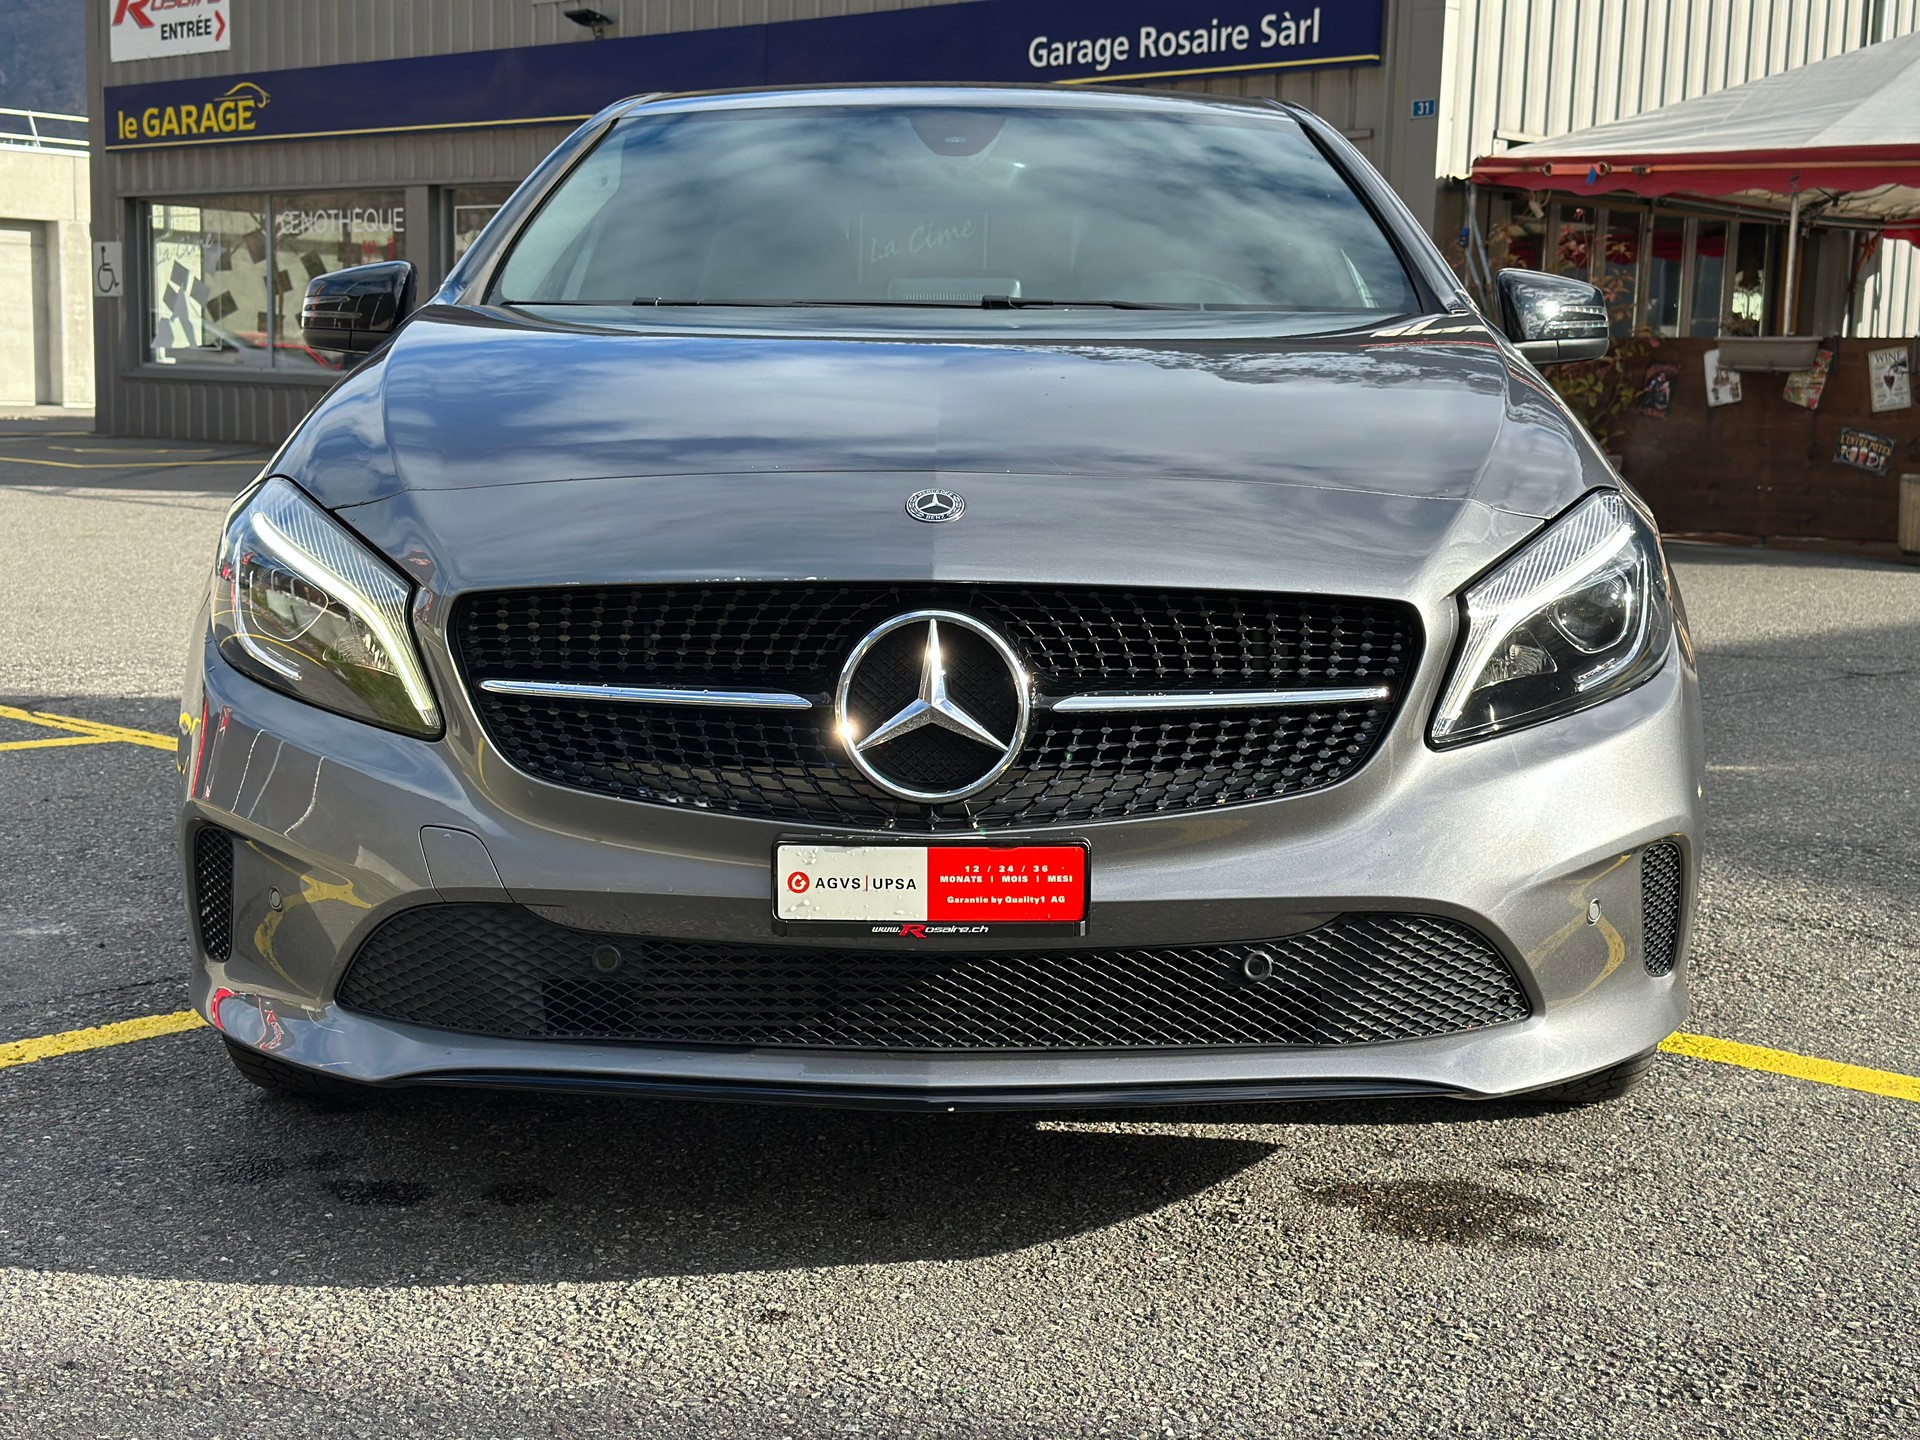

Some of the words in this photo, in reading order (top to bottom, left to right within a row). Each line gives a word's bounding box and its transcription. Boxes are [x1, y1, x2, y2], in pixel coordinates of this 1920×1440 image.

[160, 14, 212, 40] ENTRÉE
[1028, 36, 1130, 71] Garage
[1139, 18, 1250, 58] Rosaire
[1260, 7, 1321, 48] Sàrl
[1417, 102, 1430, 115] 31
[118, 110, 138, 139] le
[142, 99, 256, 138] GARAGE
[871, 236, 900, 262] La
[908, 218, 976, 253] Cime
[964, 865, 980, 873] 12
[998, 865, 1014, 873] 24
[1033, 865, 1049, 873] 36
[815, 877, 862, 889] AGVS
[872, 878, 917, 890] UPSA
[939, 875, 983, 883] MONATE
[1001, 875, 1029, 883] MOIS
[1047, 875, 1073, 883] MESI
[946, 895, 989, 904] Garantie
[991, 895, 1003, 905] by
[1004, 895, 1046, 905] Quality1
[1050, 896, 1066, 904] AG
[871, 923, 989, 938] www.Rosaire.ch
